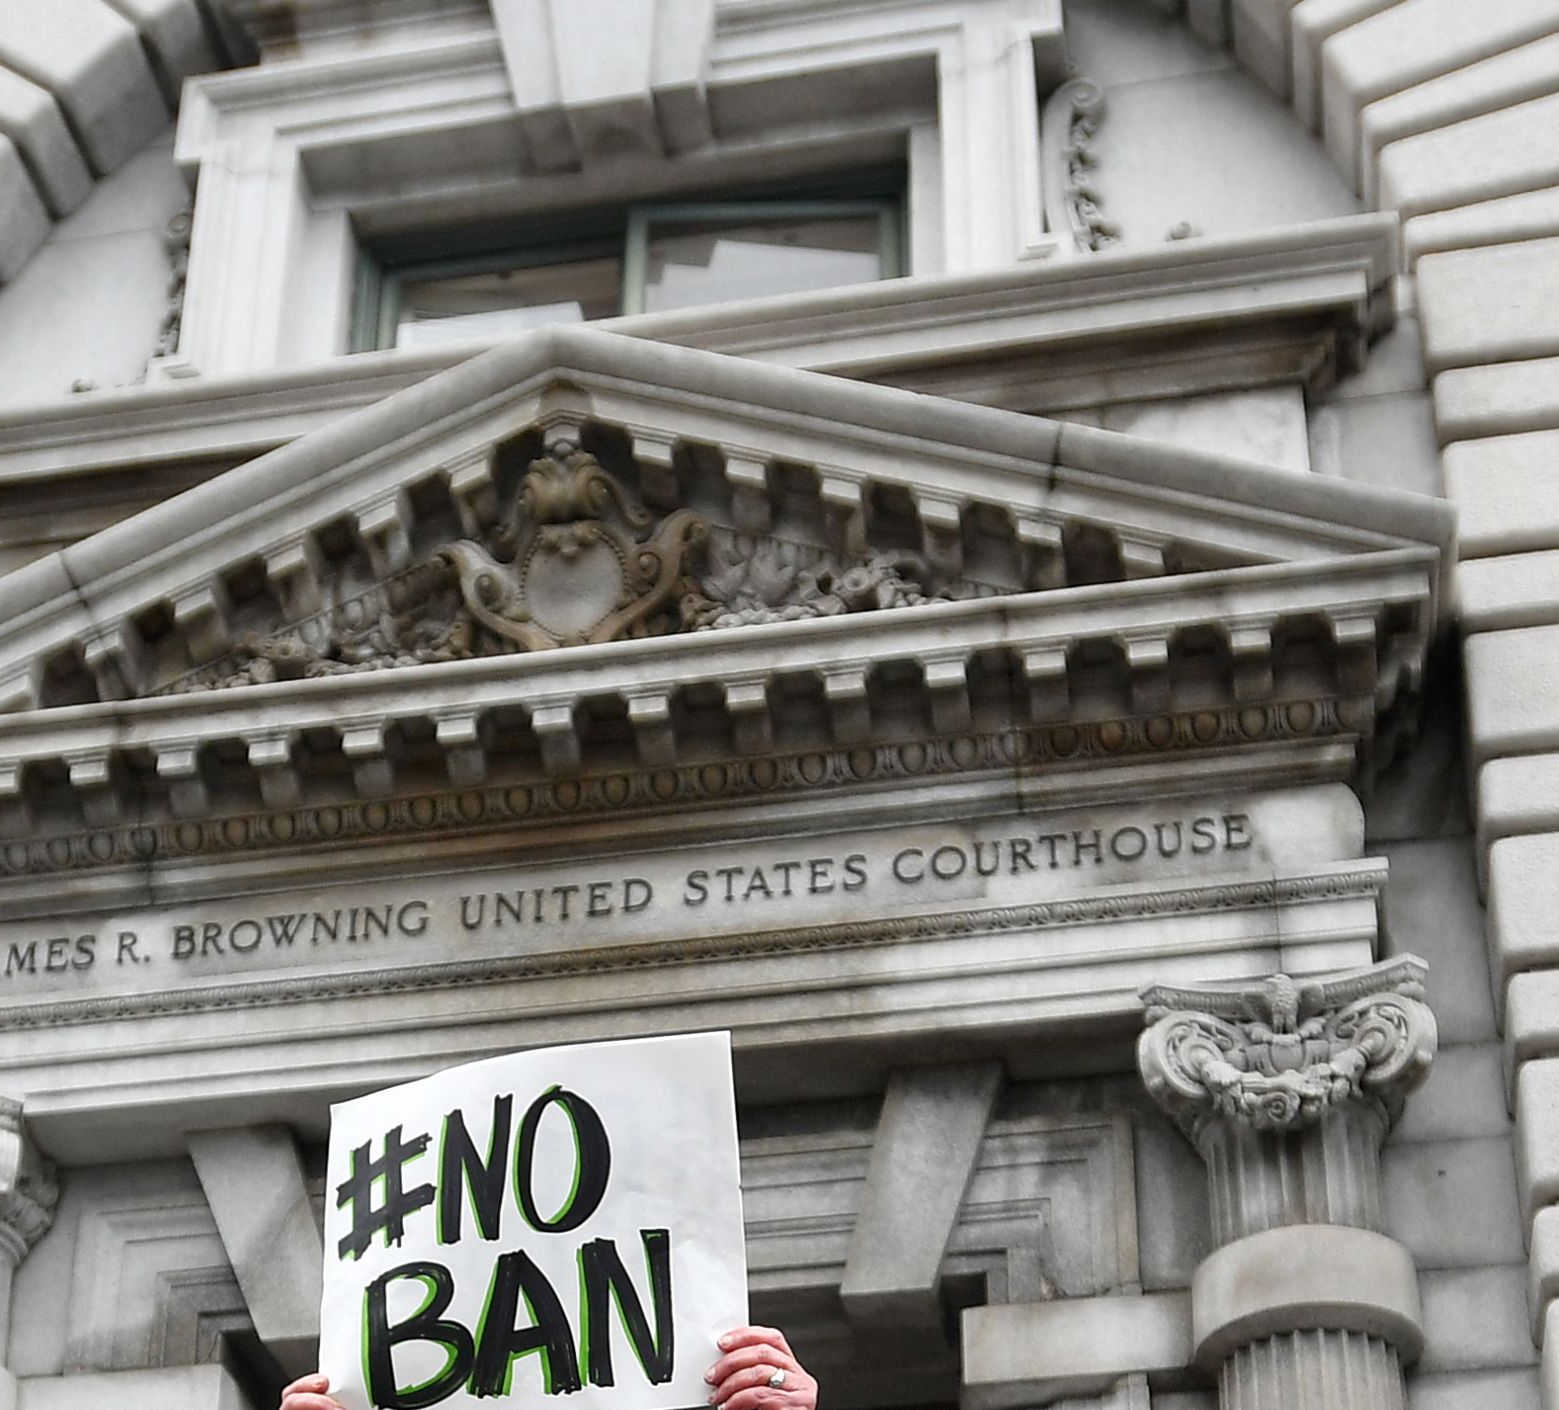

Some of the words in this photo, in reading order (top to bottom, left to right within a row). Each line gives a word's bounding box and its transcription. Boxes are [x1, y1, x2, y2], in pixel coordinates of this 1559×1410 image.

[116, 930, 151, 965] R.
[170, 899, 430, 961] BROWNING
[458, 876, 654, 930] UNITED
[683, 853, 868, 907] STATES
[891, 812, 1253, 885] COURTHOUSE
[336, 1083, 611, 1261] #NO
[360, 1228, 675, 1410] BAN
